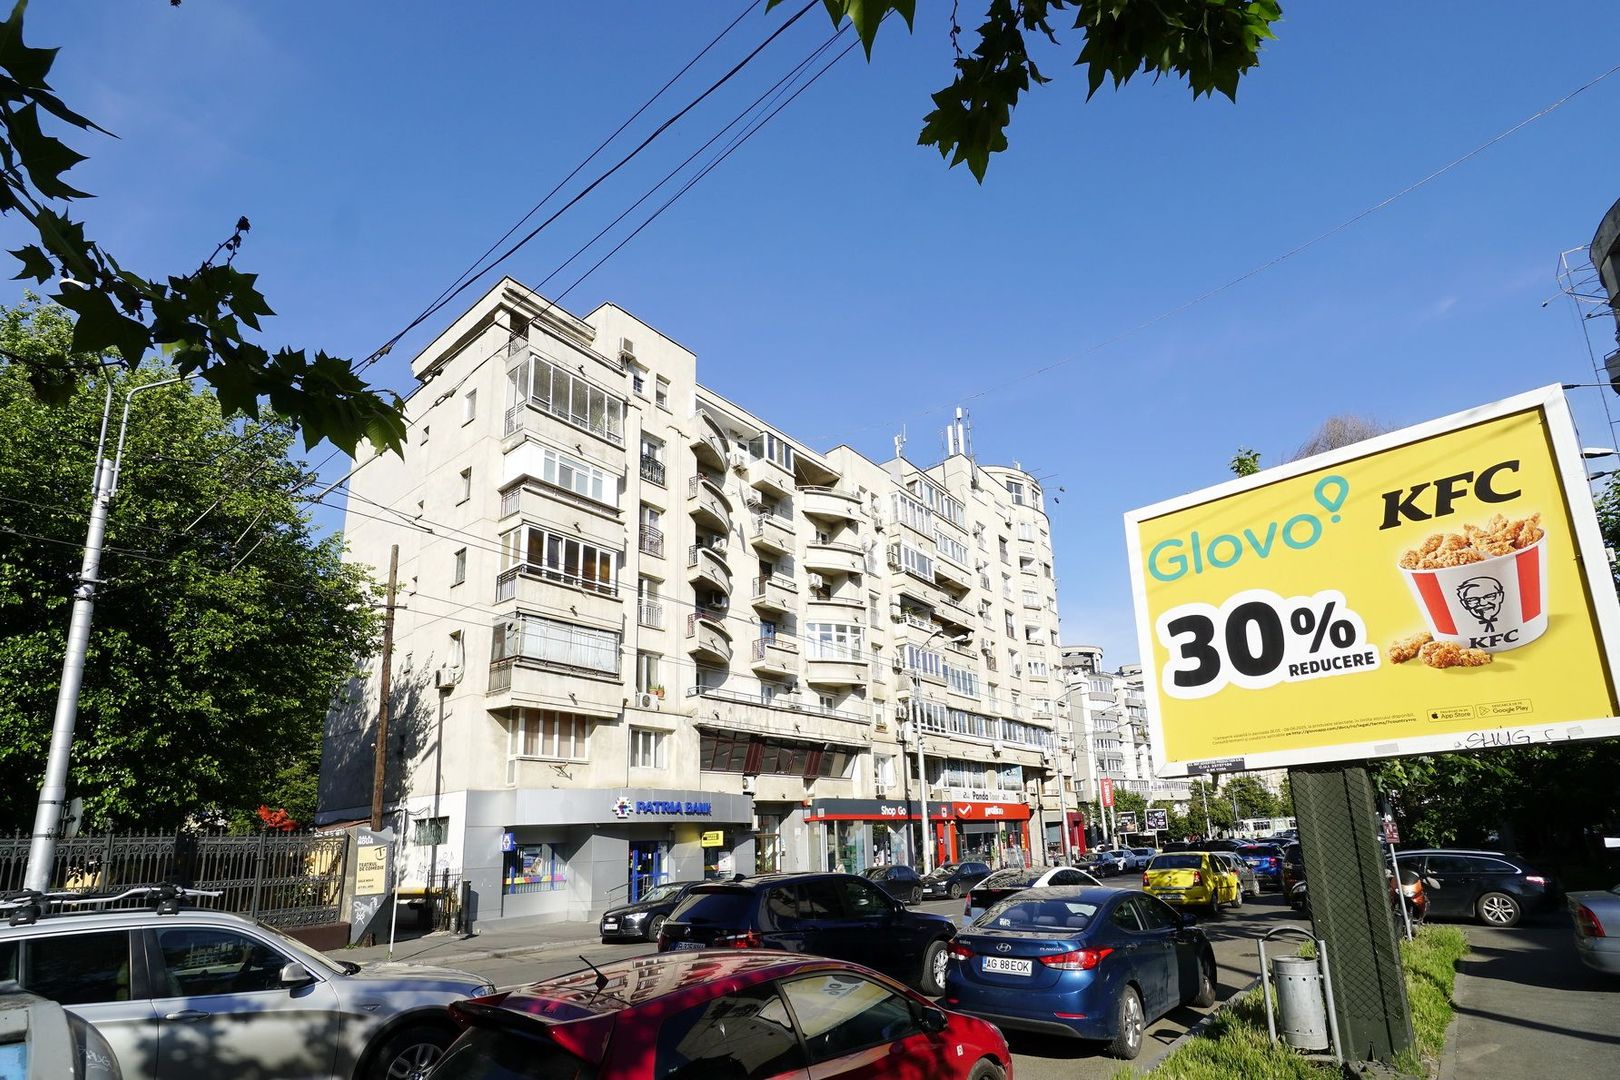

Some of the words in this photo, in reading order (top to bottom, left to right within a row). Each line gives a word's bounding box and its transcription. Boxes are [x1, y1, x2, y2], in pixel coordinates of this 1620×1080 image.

[1379, 460, 1522, 530] KFC
[1148, 514, 1322, 581] Glovo
[1167, 601, 1356, 687] 30%
[1469, 629, 1519, 649] KFC
[1289, 651, 1375, 677] REDUCERE
[1493, 706, 1515, 714] Google
[972, 791, 989, 800] Panda
[636, 801, 683, 815] PATRIA
[685, 802, 712, 816] BANK
[881, 805, 896, 816] Shop
[898, 805, 907, 815] Go
[986, 957, 998, 969] AG
